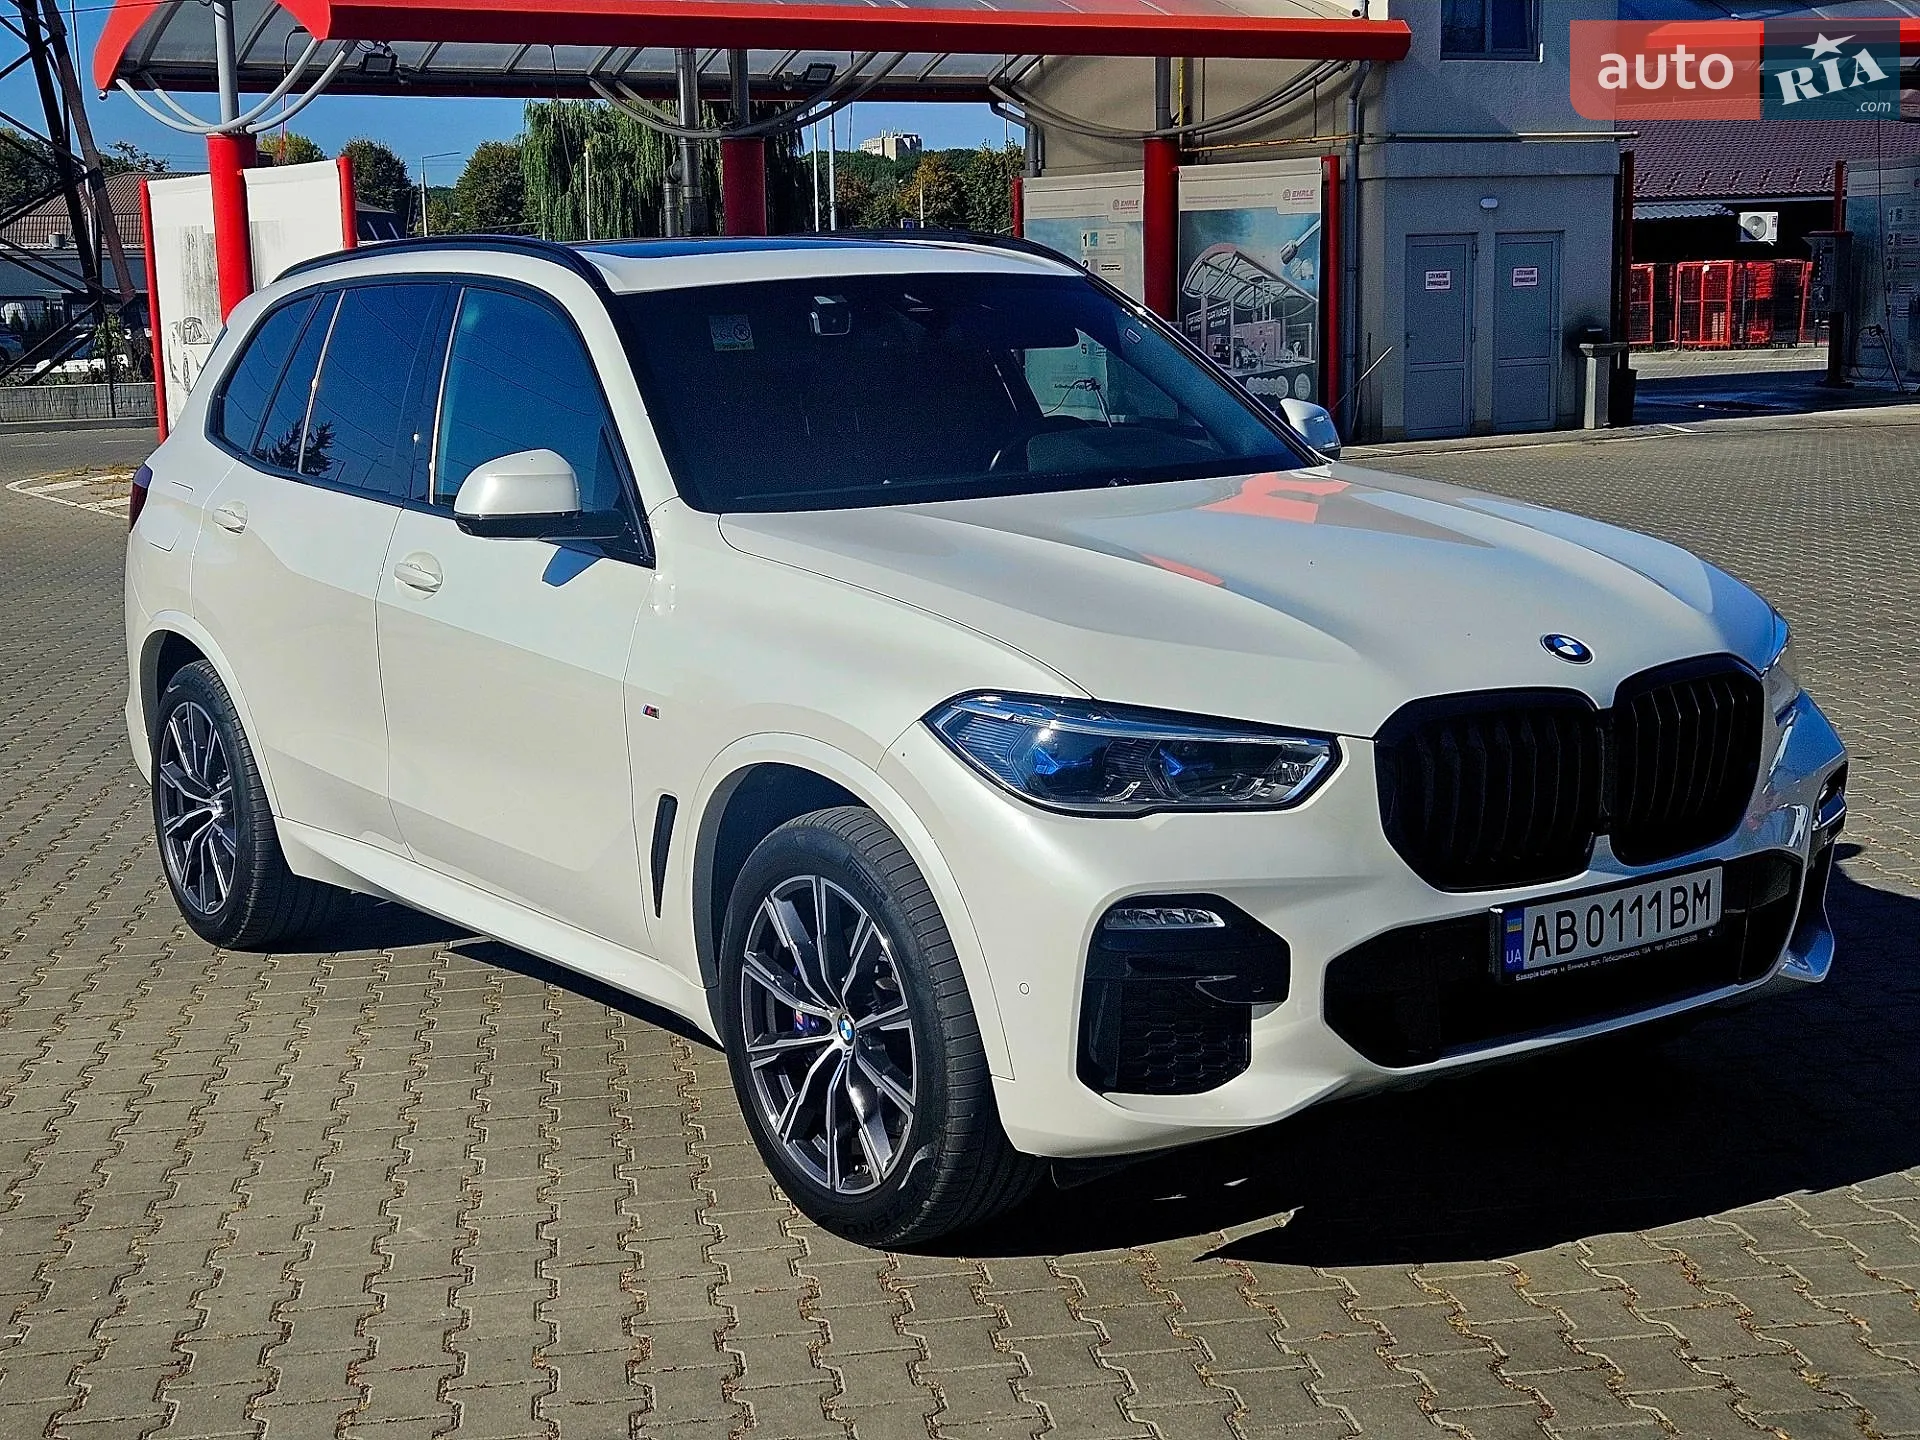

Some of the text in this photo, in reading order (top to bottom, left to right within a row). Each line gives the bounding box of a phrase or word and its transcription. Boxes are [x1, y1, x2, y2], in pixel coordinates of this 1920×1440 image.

[1082, 233, 1088, 247] 1
[1081, 343, 1088, 355] 5
[1528, 878, 1712, 962] AB0111BM
[1506, 949, 1522, 964] UA
